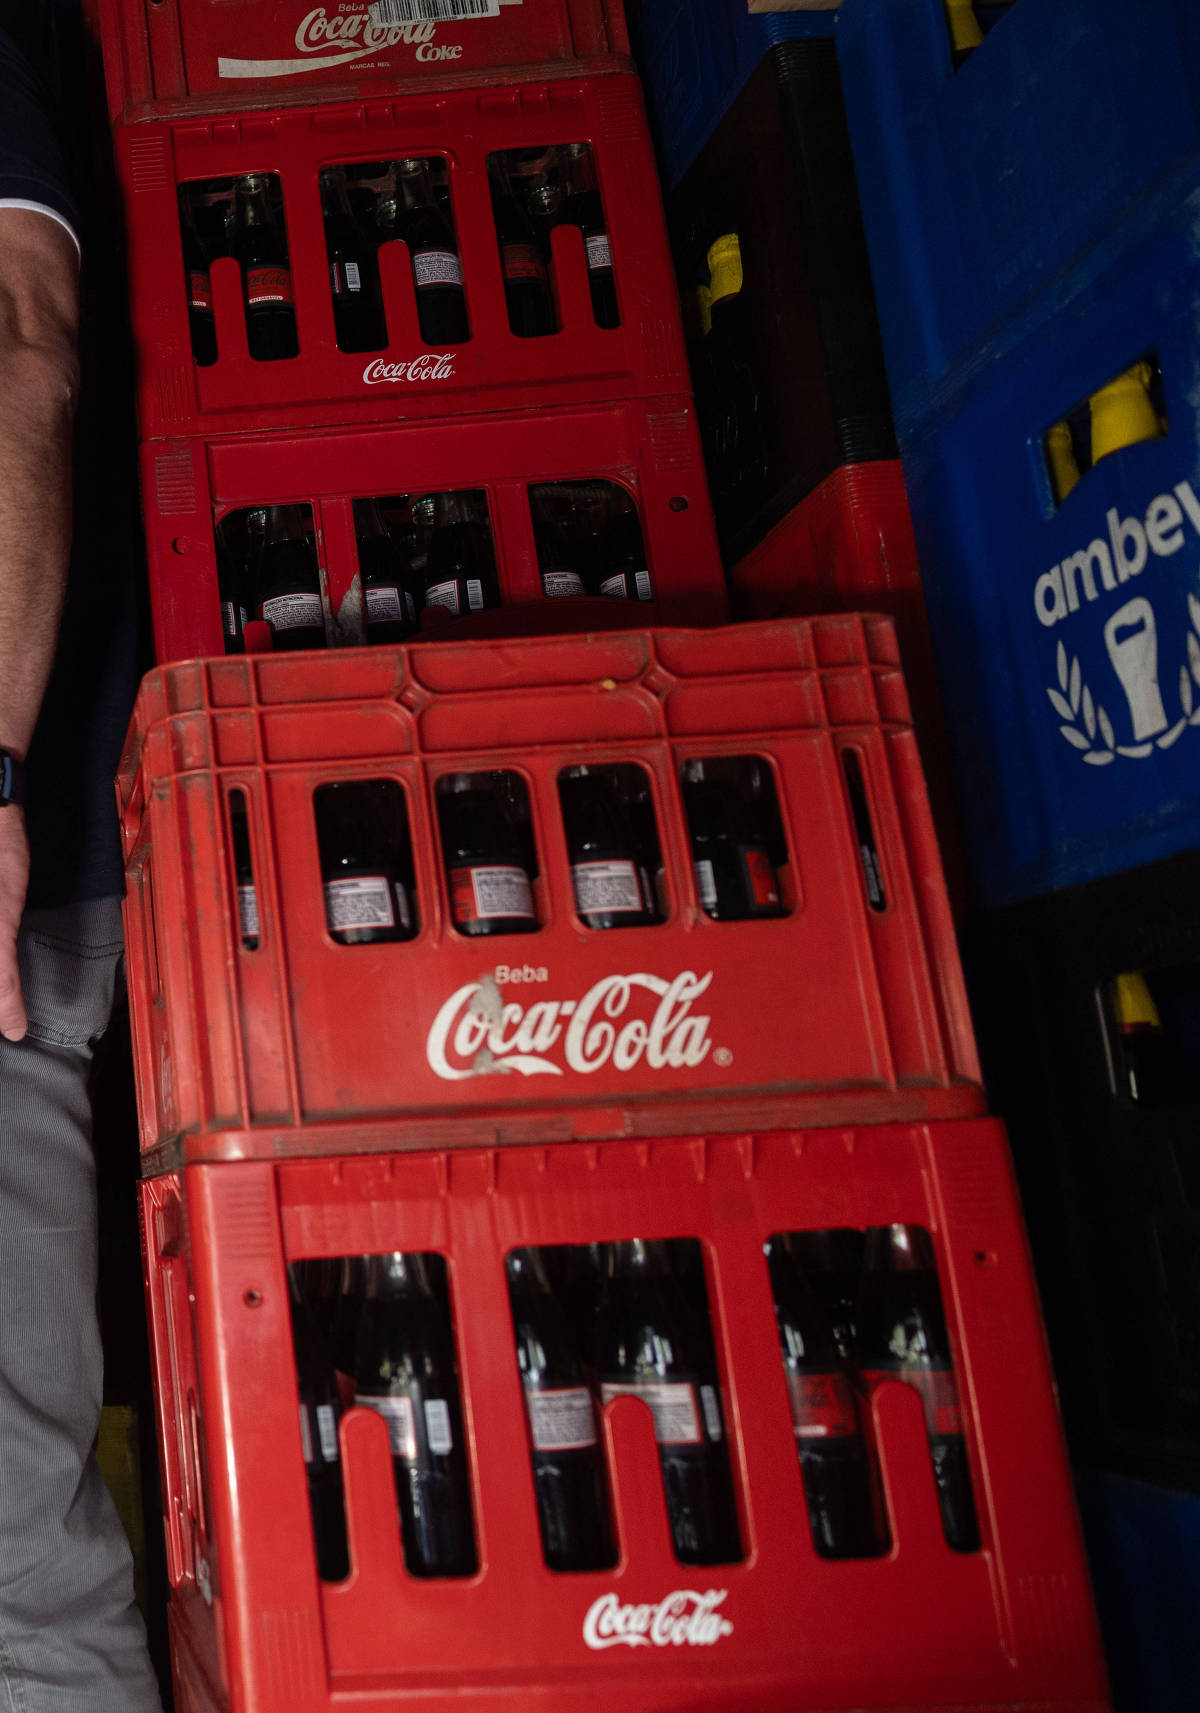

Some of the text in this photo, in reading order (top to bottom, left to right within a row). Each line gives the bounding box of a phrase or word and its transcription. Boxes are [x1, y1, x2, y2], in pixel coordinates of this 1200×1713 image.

[415, 42, 463, 63] Coke
[363, 353, 456, 385] Coca-Cola
[495, 964, 549, 984] Beba
[426, 969, 714, 1081] Coca-Cola
[582, 1589, 727, 1650] Coca-Cola
